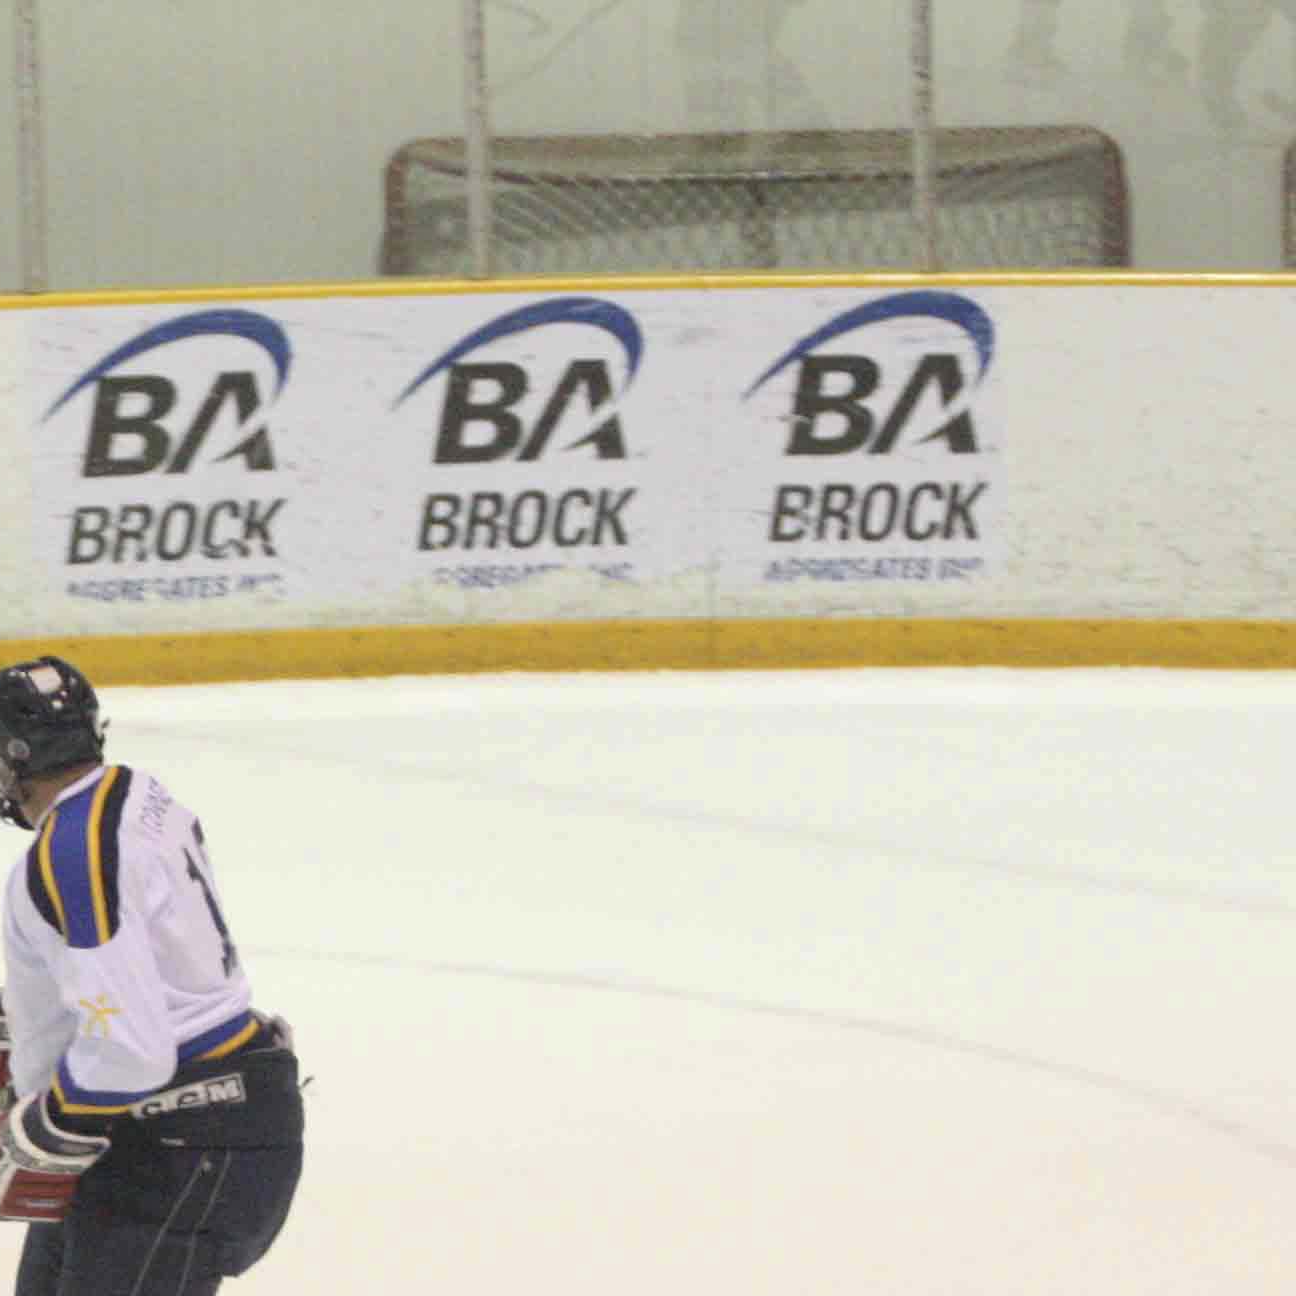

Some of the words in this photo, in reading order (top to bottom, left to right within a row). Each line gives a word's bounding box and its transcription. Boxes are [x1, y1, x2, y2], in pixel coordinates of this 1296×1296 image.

[81, 371, 276, 479] BA
[433, 358, 627, 465] BA
[784, 354, 981, 456] BA
[66, 498, 287, 566] BROCK
[418, 487, 640, 552] BROCK
[768, 481, 990, 543] BROCK
[134, 1074, 246, 1120] CCM
